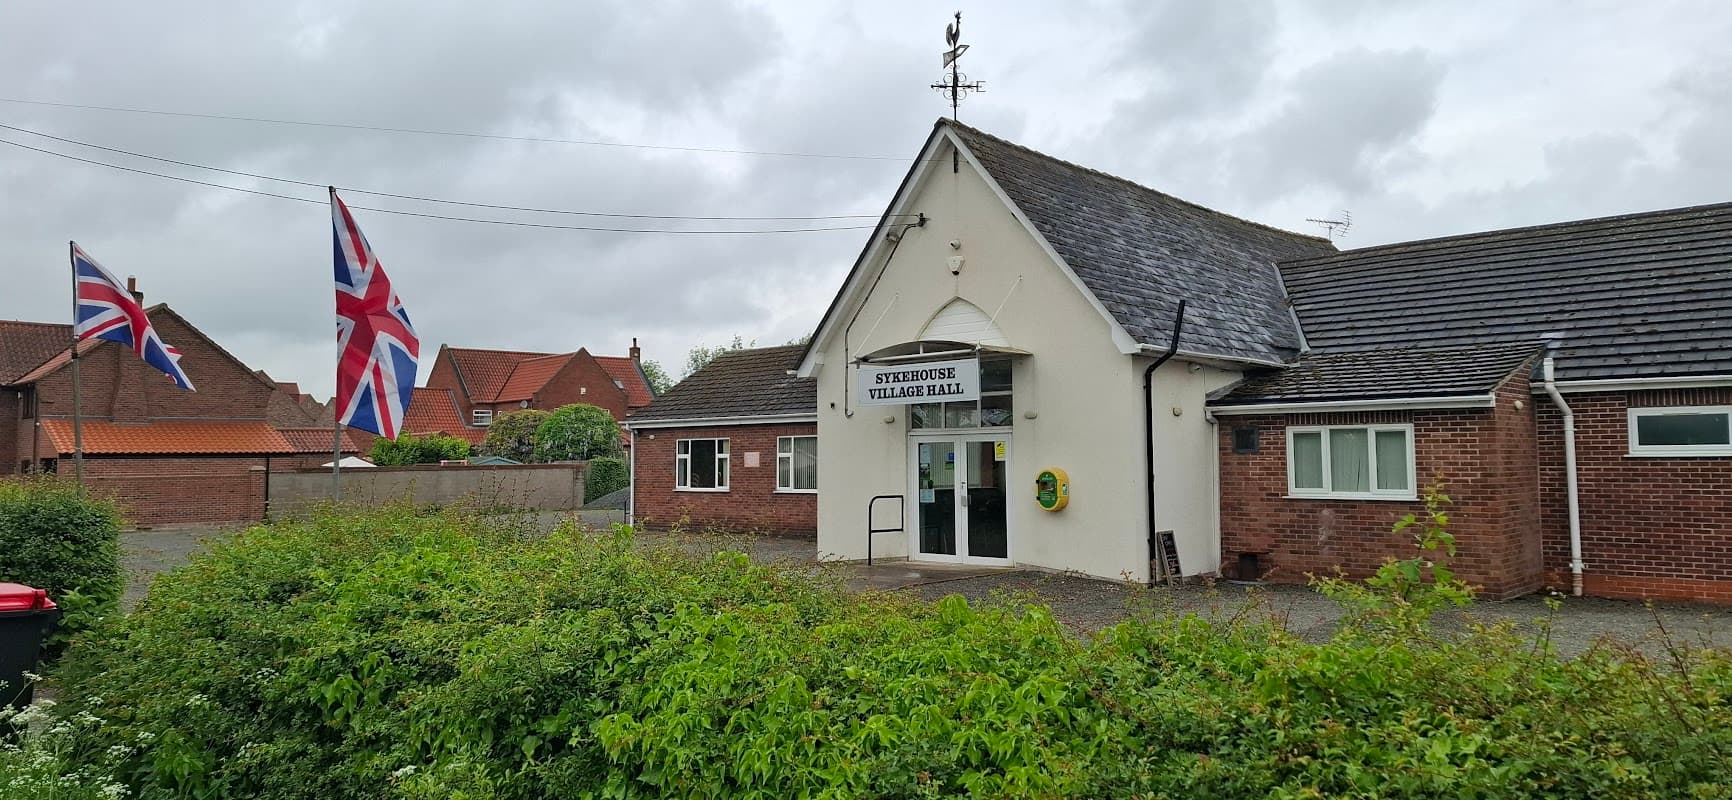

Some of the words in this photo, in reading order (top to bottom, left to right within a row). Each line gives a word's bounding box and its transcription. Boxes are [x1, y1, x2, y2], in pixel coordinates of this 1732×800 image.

[976, 80, 986, 92] E
[875, 367, 956, 384] SYKEHOUSE
[869, 385, 924, 399] VILLAGE
[926, 383, 964, 396] HALL
